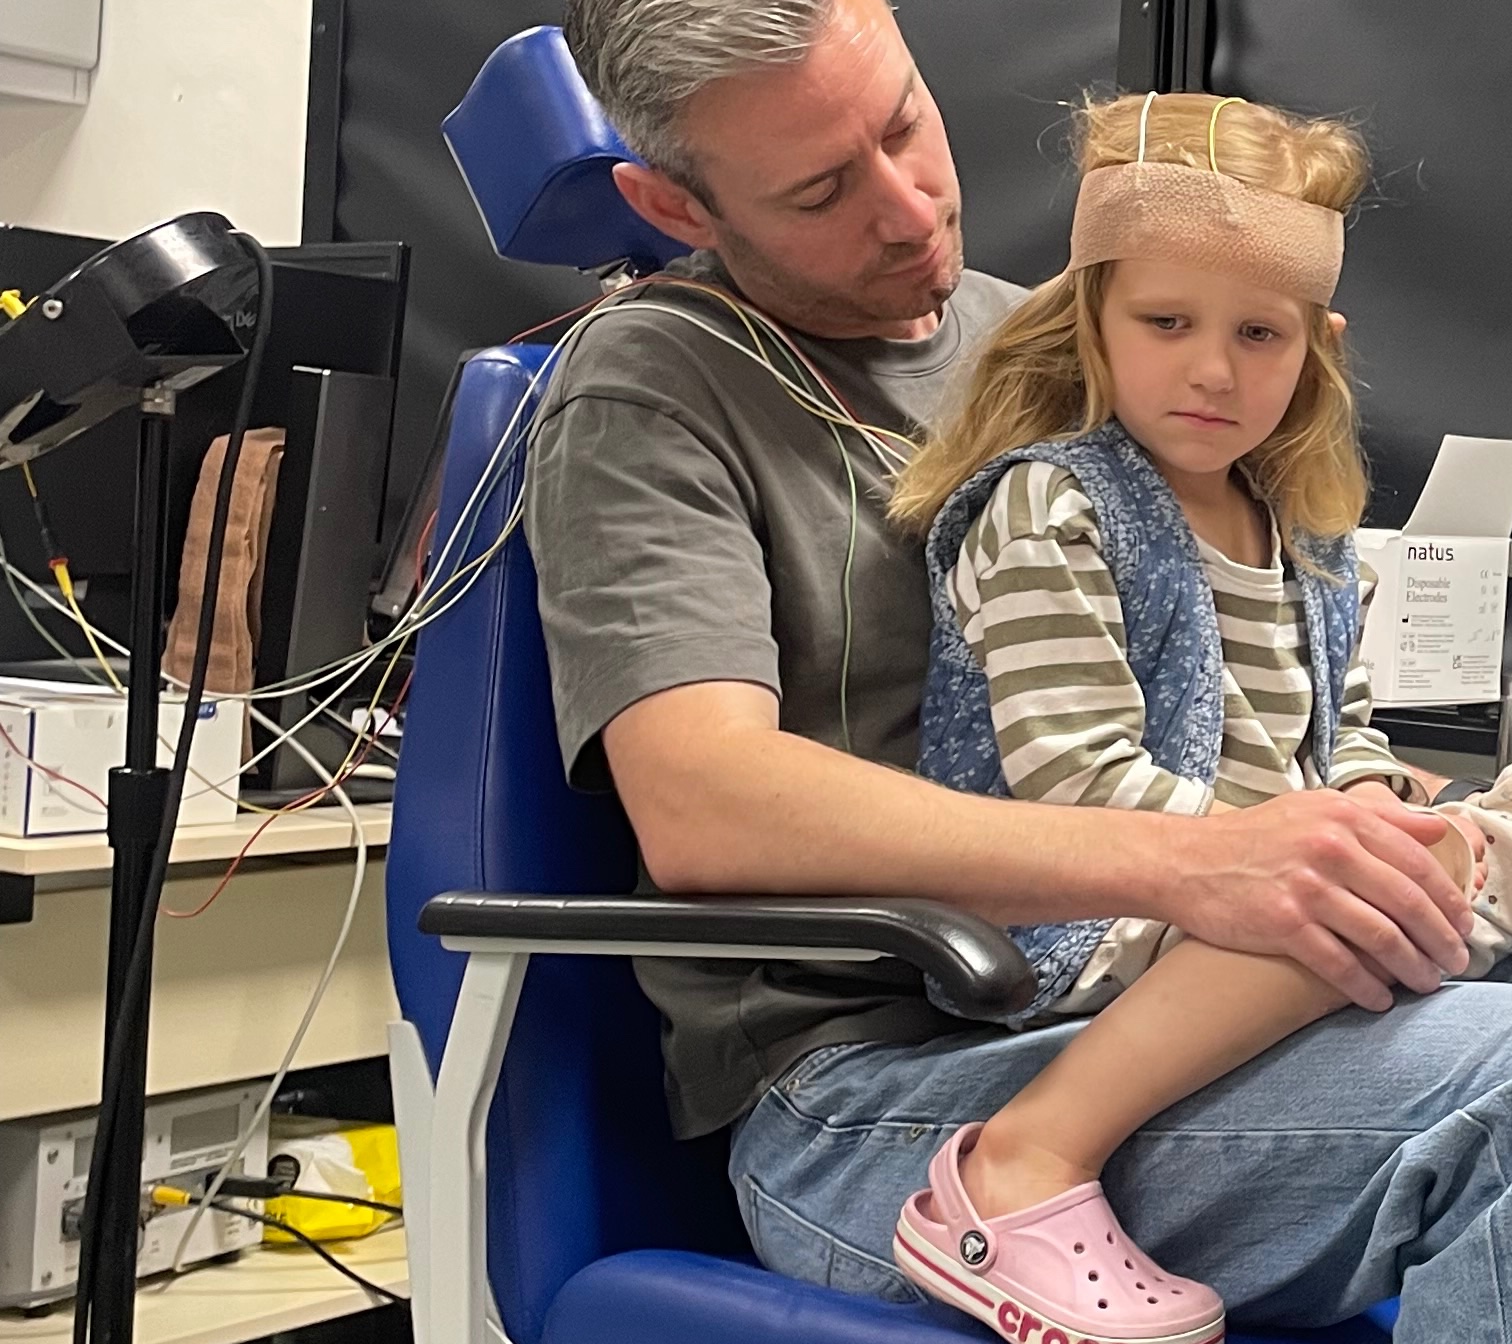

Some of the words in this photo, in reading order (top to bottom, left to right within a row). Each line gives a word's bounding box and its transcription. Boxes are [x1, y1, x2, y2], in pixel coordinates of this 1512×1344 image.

[1407, 542, 1455, 562] natus
[1406, 576, 1451, 591] Disposable
[1406, 590, 1448, 604] Electrodes
